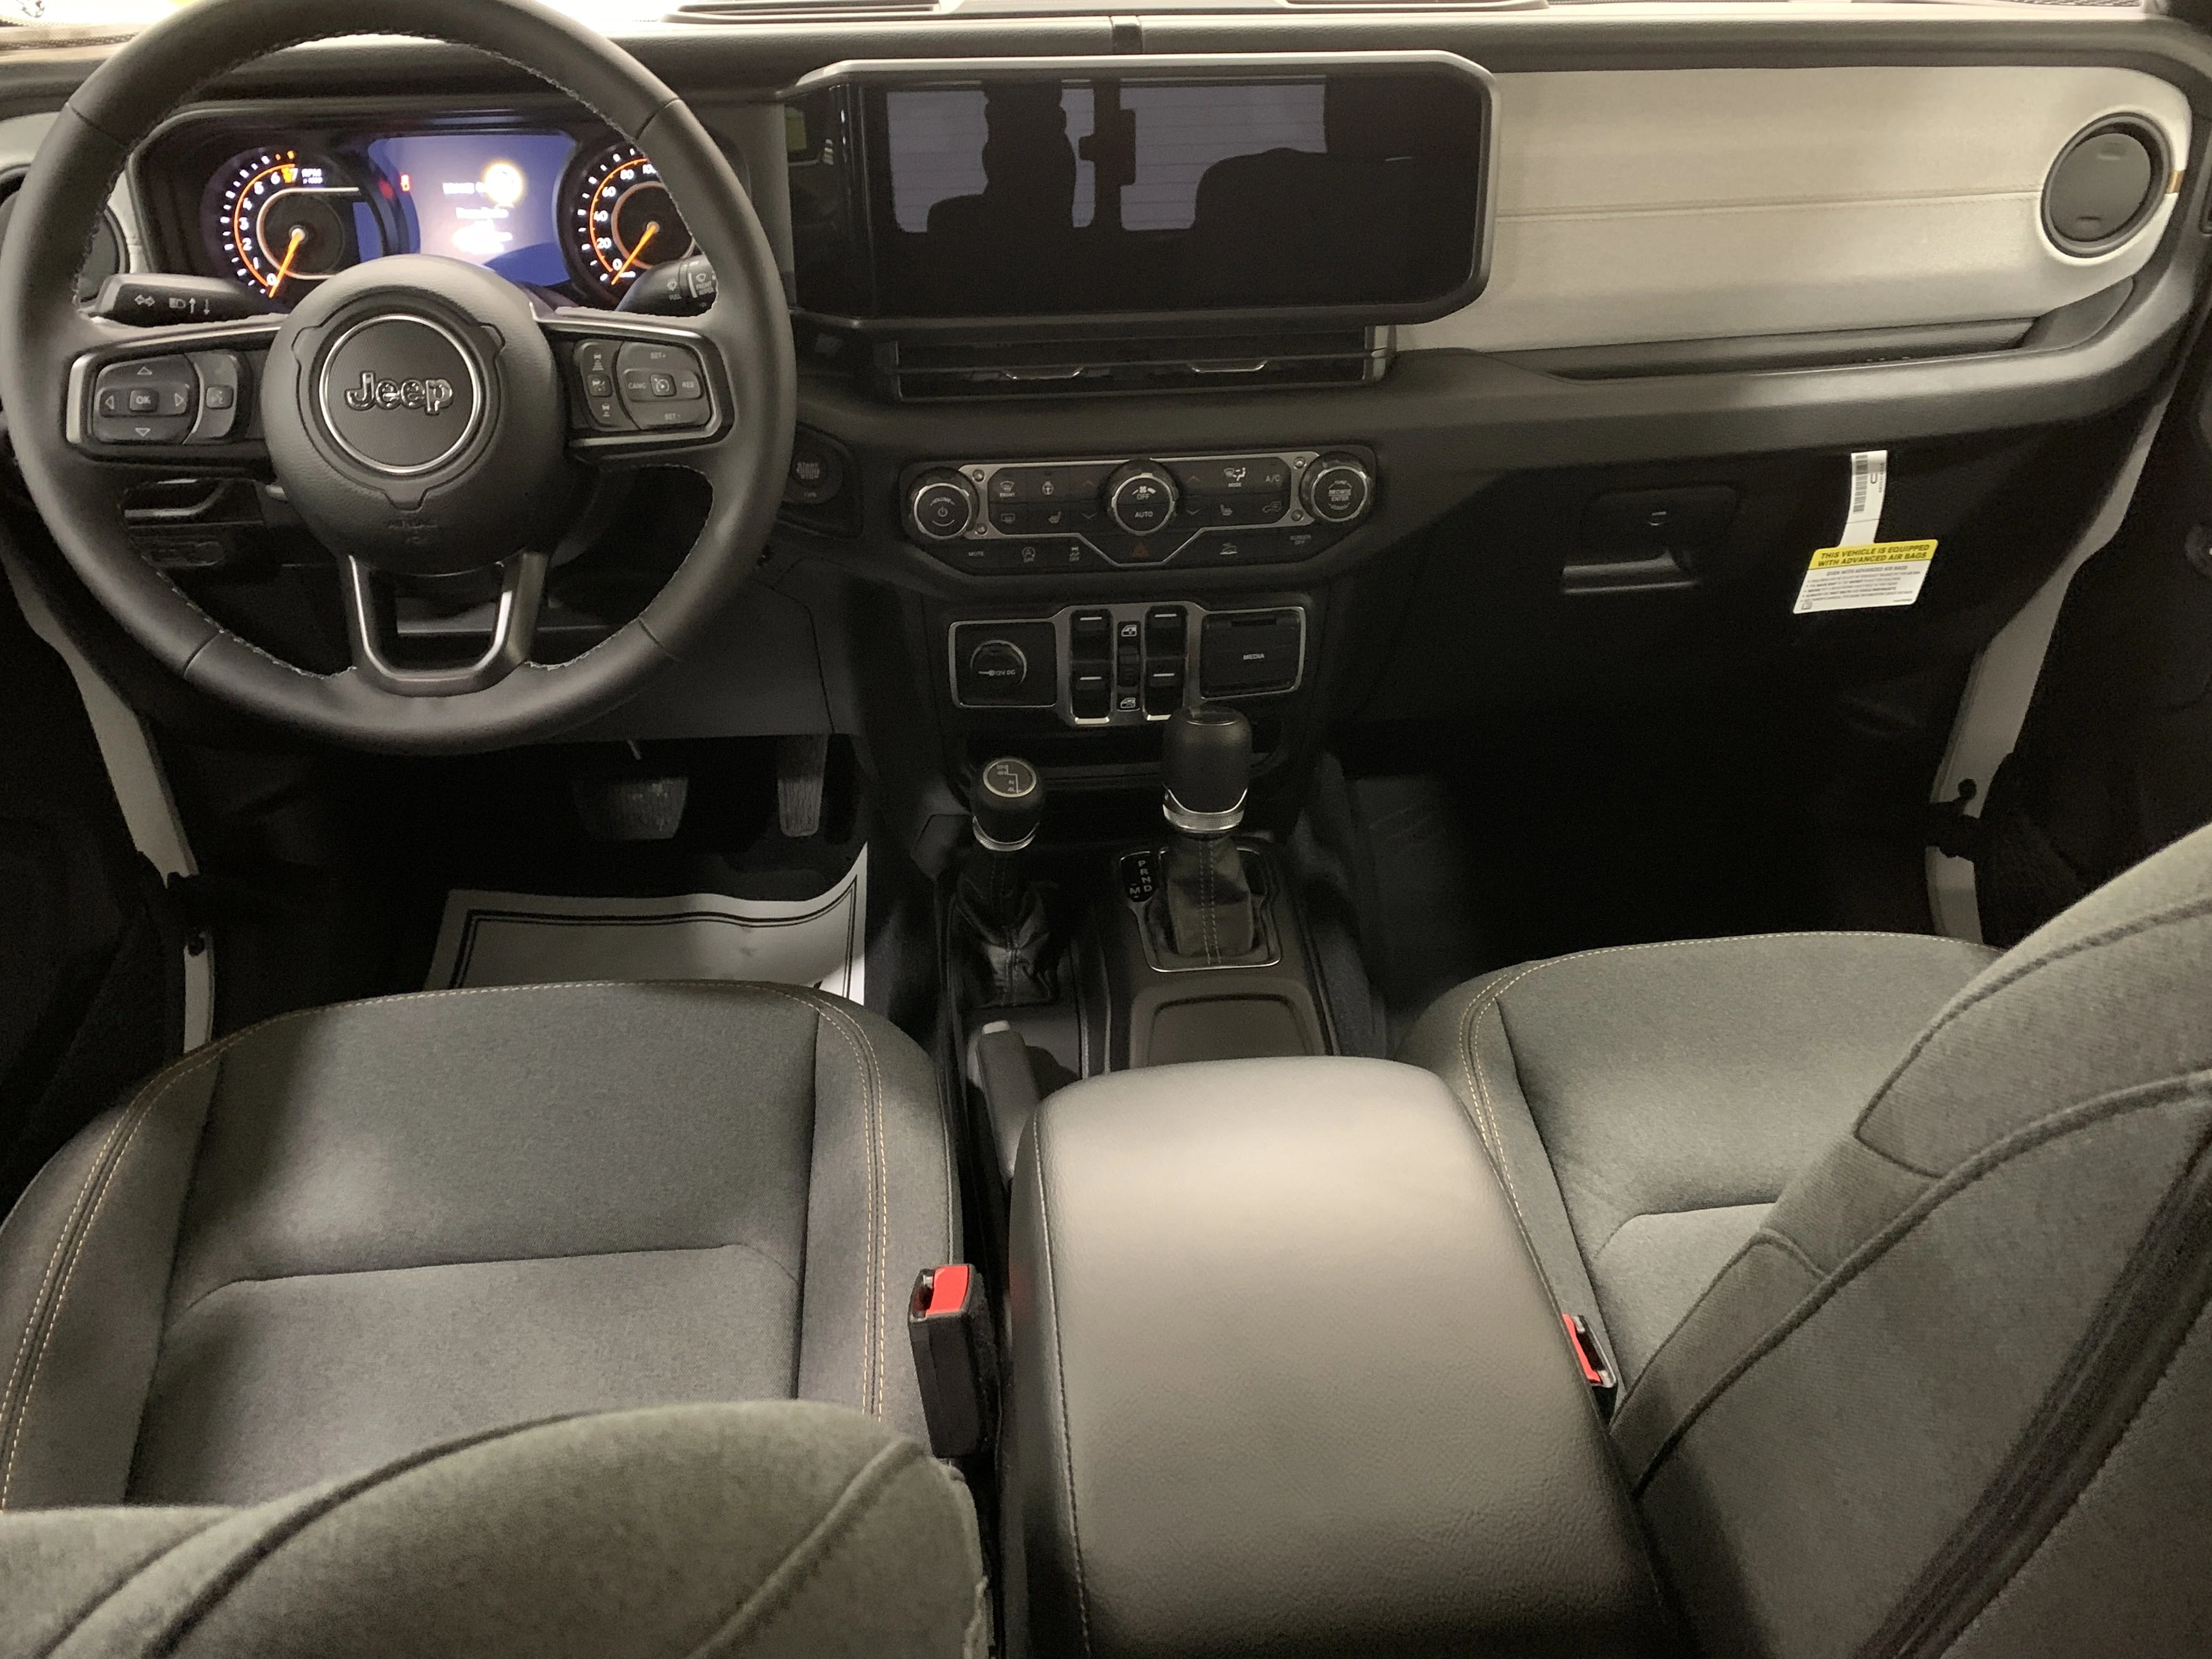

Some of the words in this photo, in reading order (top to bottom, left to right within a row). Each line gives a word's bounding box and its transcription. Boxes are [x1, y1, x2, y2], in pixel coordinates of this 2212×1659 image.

[271, 172, 280, 184] 6
[289, 168, 298, 182] 7
[620, 169, 634, 180] 80
[254, 182, 264, 195] 5
[602, 185, 616, 197] 60
[242, 198, 252, 210] 4
[594, 210, 608, 222] 40
[239, 217, 249, 230] 3
[242, 238, 252, 251] 2
[597, 237, 612, 249] 20
[253, 257, 259, 270] 1
[612, 258, 623, 271] 0
[267, 273, 276, 285] 0
[344, 370, 454, 415] Jeep
[136, 394, 151, 405] OK
[1265, 474, 1280, 483] A/C
[1134, 510, 1153, 518] AUTO
[1841, 548, 1876, 557] VEHICLE
[1887, 544, 1930, 553] EQUIPPED
[1841, 555, 1887, 565] ADVANCED
[1143, 884, 1152, 893] D
